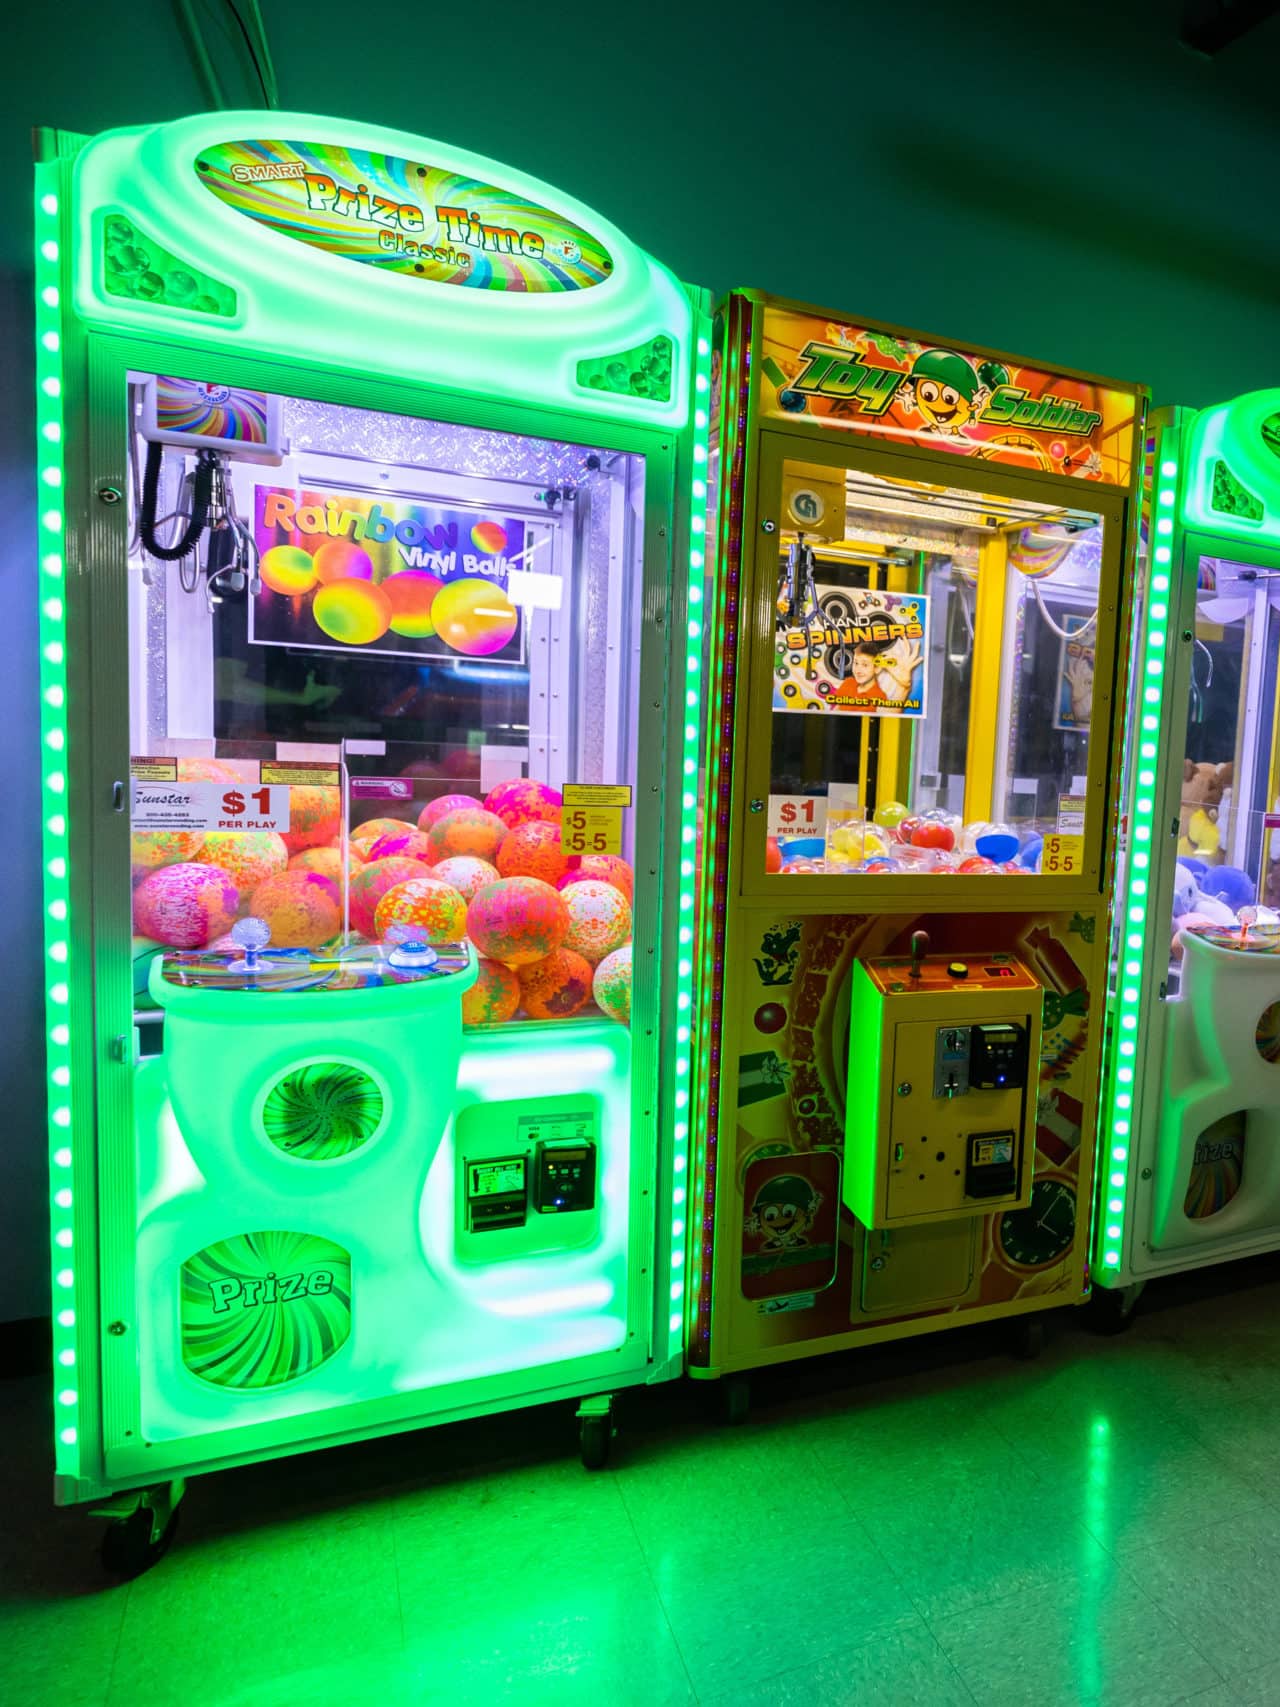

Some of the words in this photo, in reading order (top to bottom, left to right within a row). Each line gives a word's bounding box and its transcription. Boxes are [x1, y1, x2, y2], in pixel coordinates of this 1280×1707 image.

[231, 162, 305, 183] SMART
[303, 172, 424, 232] Prize
[435, 205, 545, 259] Time
[379, 230, 471, 267] Classic
[792, 340, 912, 416] Toy
[978, 384, 1103, 436] Soldier
[263, 493, 458, 550] Rainbow
[399, 547, 455, 575] Vinyl
[462, 553, 516, 577] Balls
[824, 616, 870, 628] HAND
[786, 623, 924, 650] SPINNERS
[825, 695, 869, 706] Collect
[870, 697, 904, 707] Them
[904, 700, 920, 708] All
[222, 788, 271, 816] $1
[780, 799, 814, 824] $1
[218, 820, 243, 829] PER
[247, 821, 277, 829] PLAY
[566, 811, 587, 830] $5
[777, 827, 793, 835] PER
[208, 1270, 334, 1313] Prize
